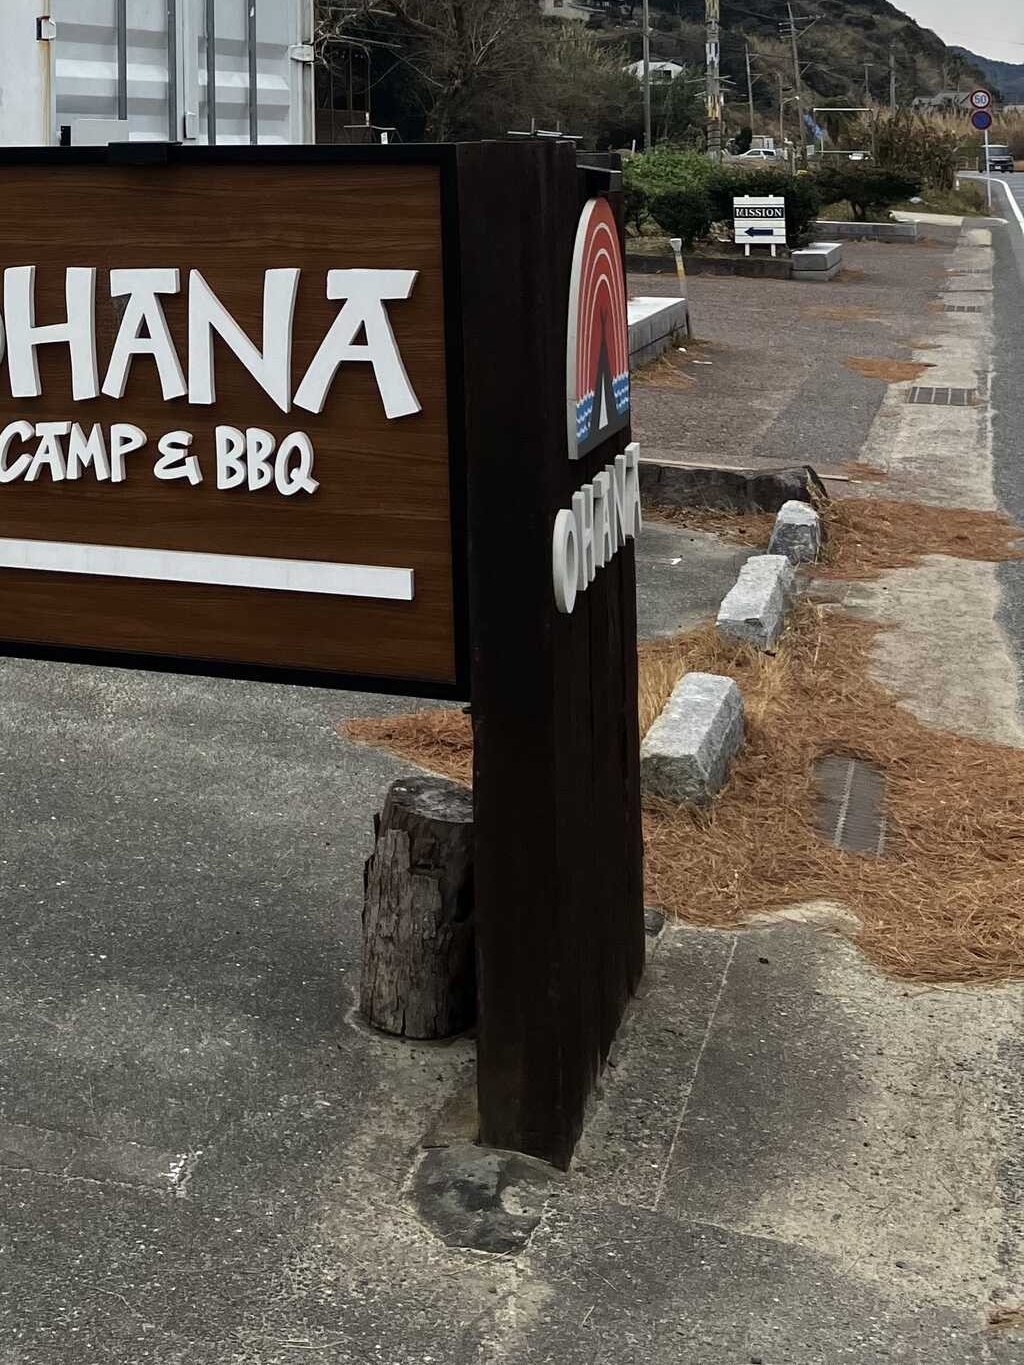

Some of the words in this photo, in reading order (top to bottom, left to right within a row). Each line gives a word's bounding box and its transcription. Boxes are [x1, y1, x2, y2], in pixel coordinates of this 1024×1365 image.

[975, 94, 987, 105] 50
[736, 208, 782, 217] MISSION
[153, 431, 203, 486] &
[215, 425, 320, 496] BBQ
[552, 442, 643, 614] OHANA
